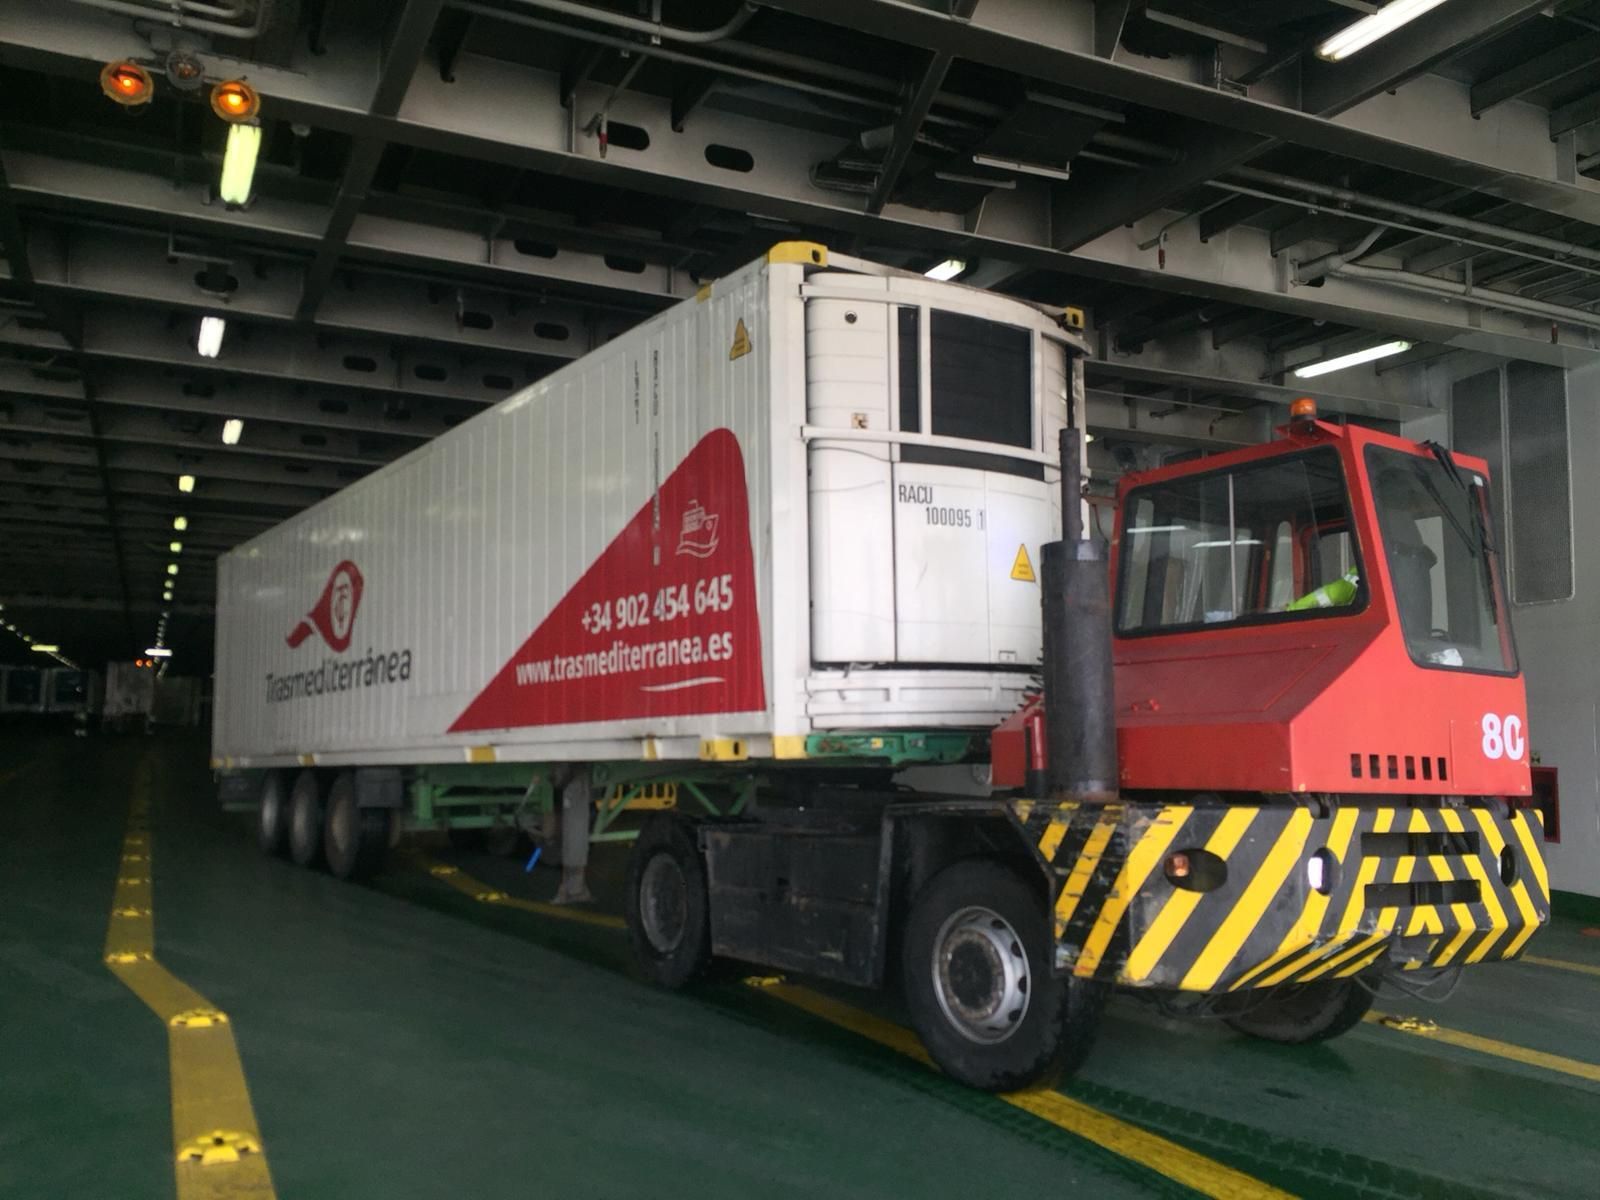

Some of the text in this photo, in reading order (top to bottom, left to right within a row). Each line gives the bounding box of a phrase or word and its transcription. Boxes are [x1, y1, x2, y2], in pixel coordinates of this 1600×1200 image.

[899, 484, 933, 504] RACU
[926, 507, 972, 527] 100095
[582, 574, 734, 634] +34 902 454 645
[516, 631, 733, 686] www.trasmediterranea.es
[1481, 712, 1525, 760] 80
